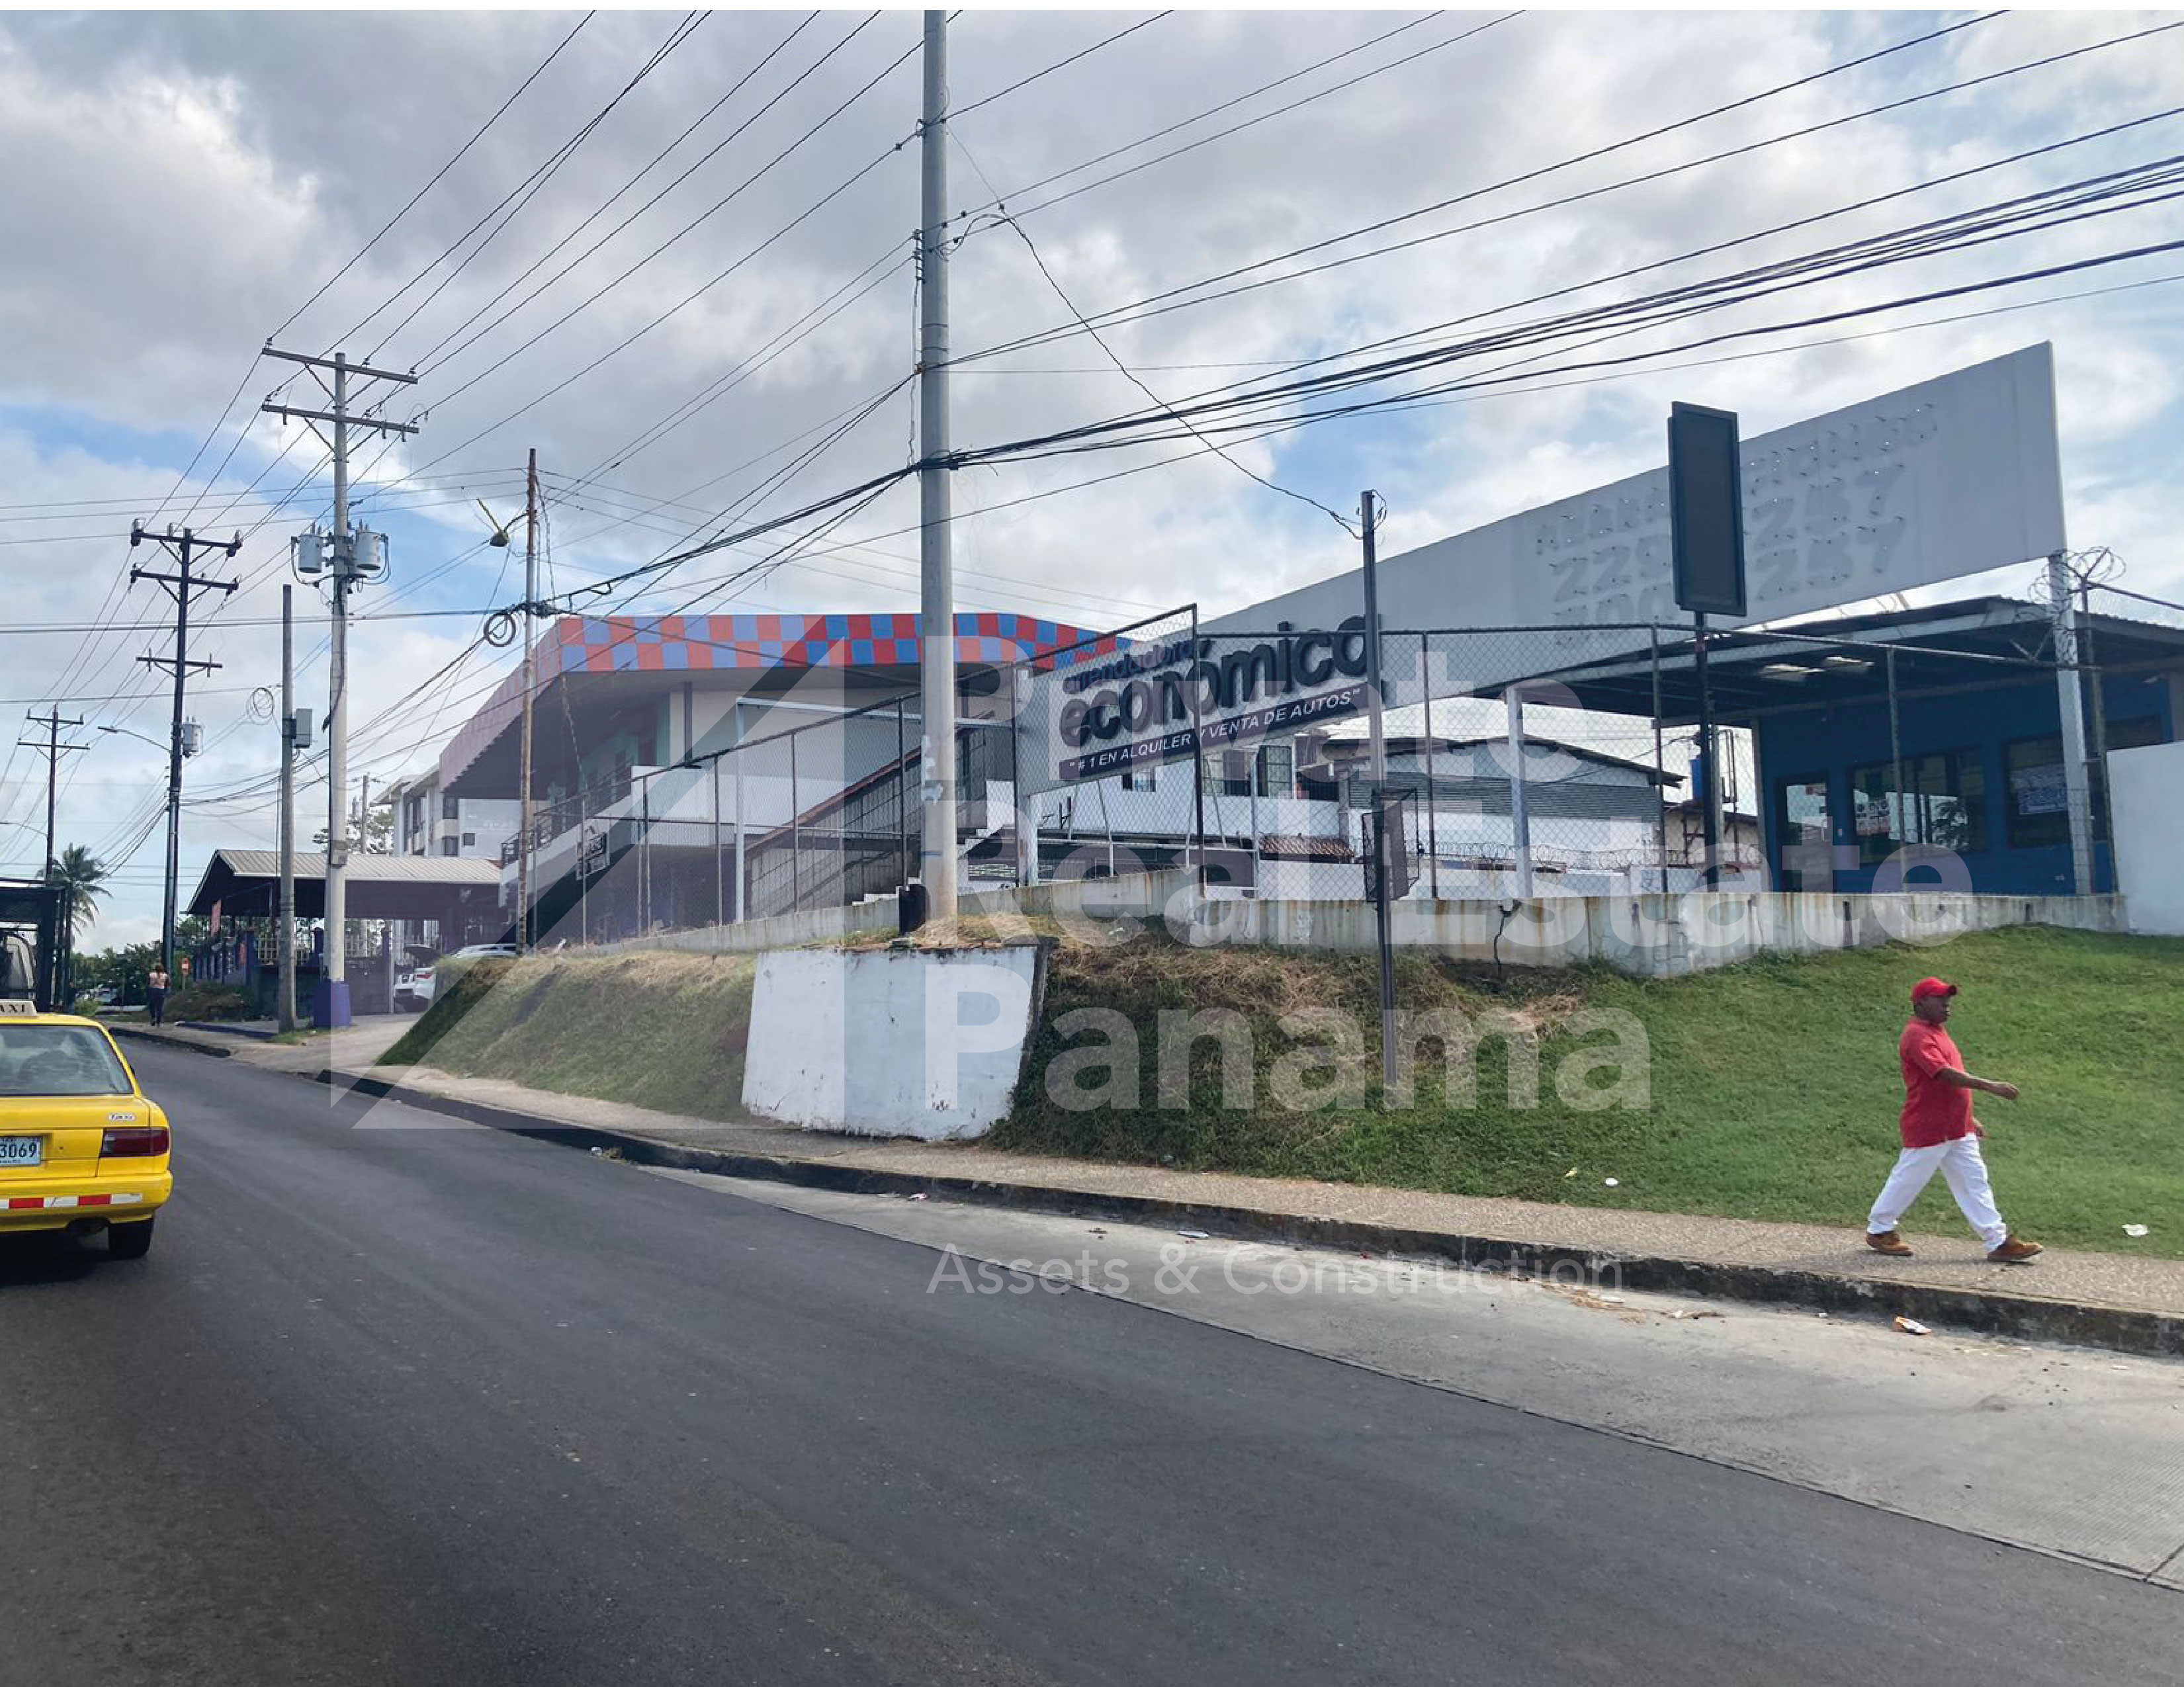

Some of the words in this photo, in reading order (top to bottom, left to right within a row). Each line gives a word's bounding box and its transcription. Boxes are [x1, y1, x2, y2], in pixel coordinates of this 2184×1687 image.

[1099, 750, 1117, 766] EN
[1119, 733, 1191, 761] ALQUILER
[1209, 715, 1258, 738] VENTA
[1263, 707, 1286, 724] DE
